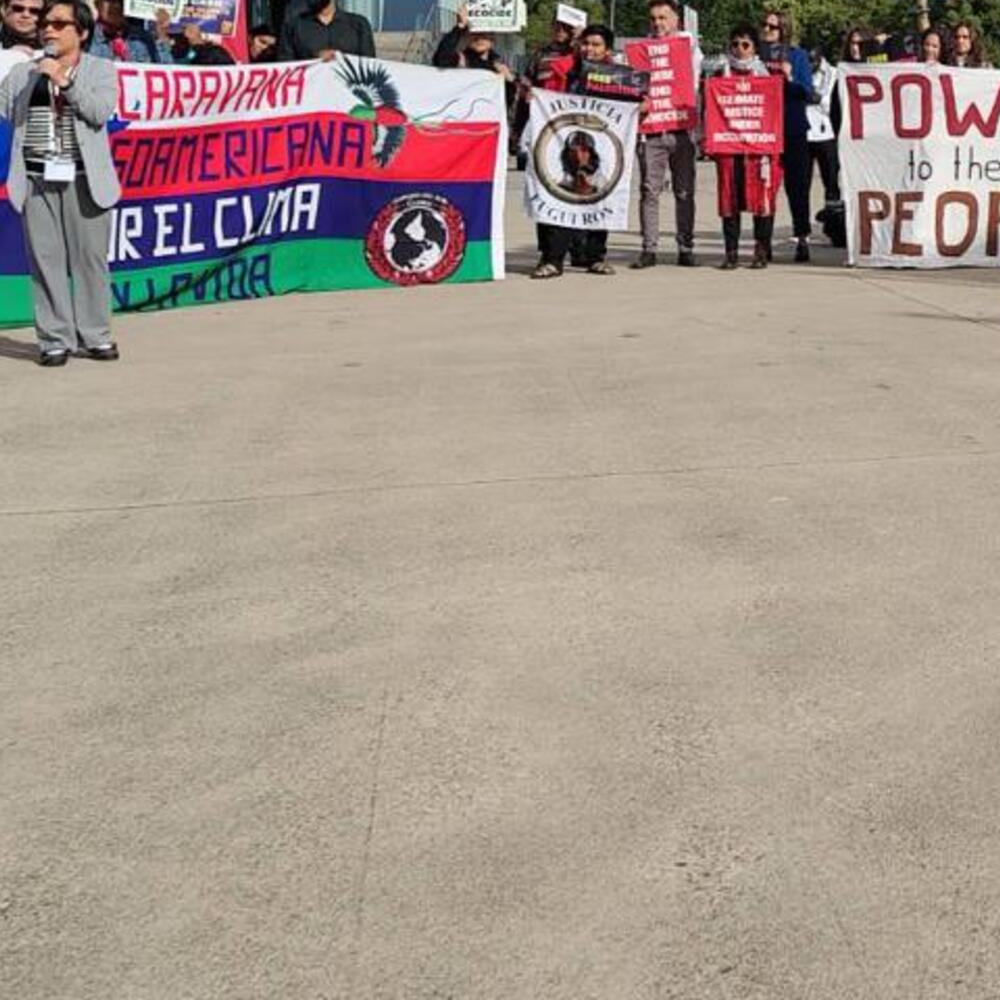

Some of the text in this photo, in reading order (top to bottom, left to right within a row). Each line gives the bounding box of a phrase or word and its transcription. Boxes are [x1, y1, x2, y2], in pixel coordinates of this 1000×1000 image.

[117, 66, 306, 121] CARAVANA
[908, 149, 933, 181] to
[153, 202, 205, 257] EL
